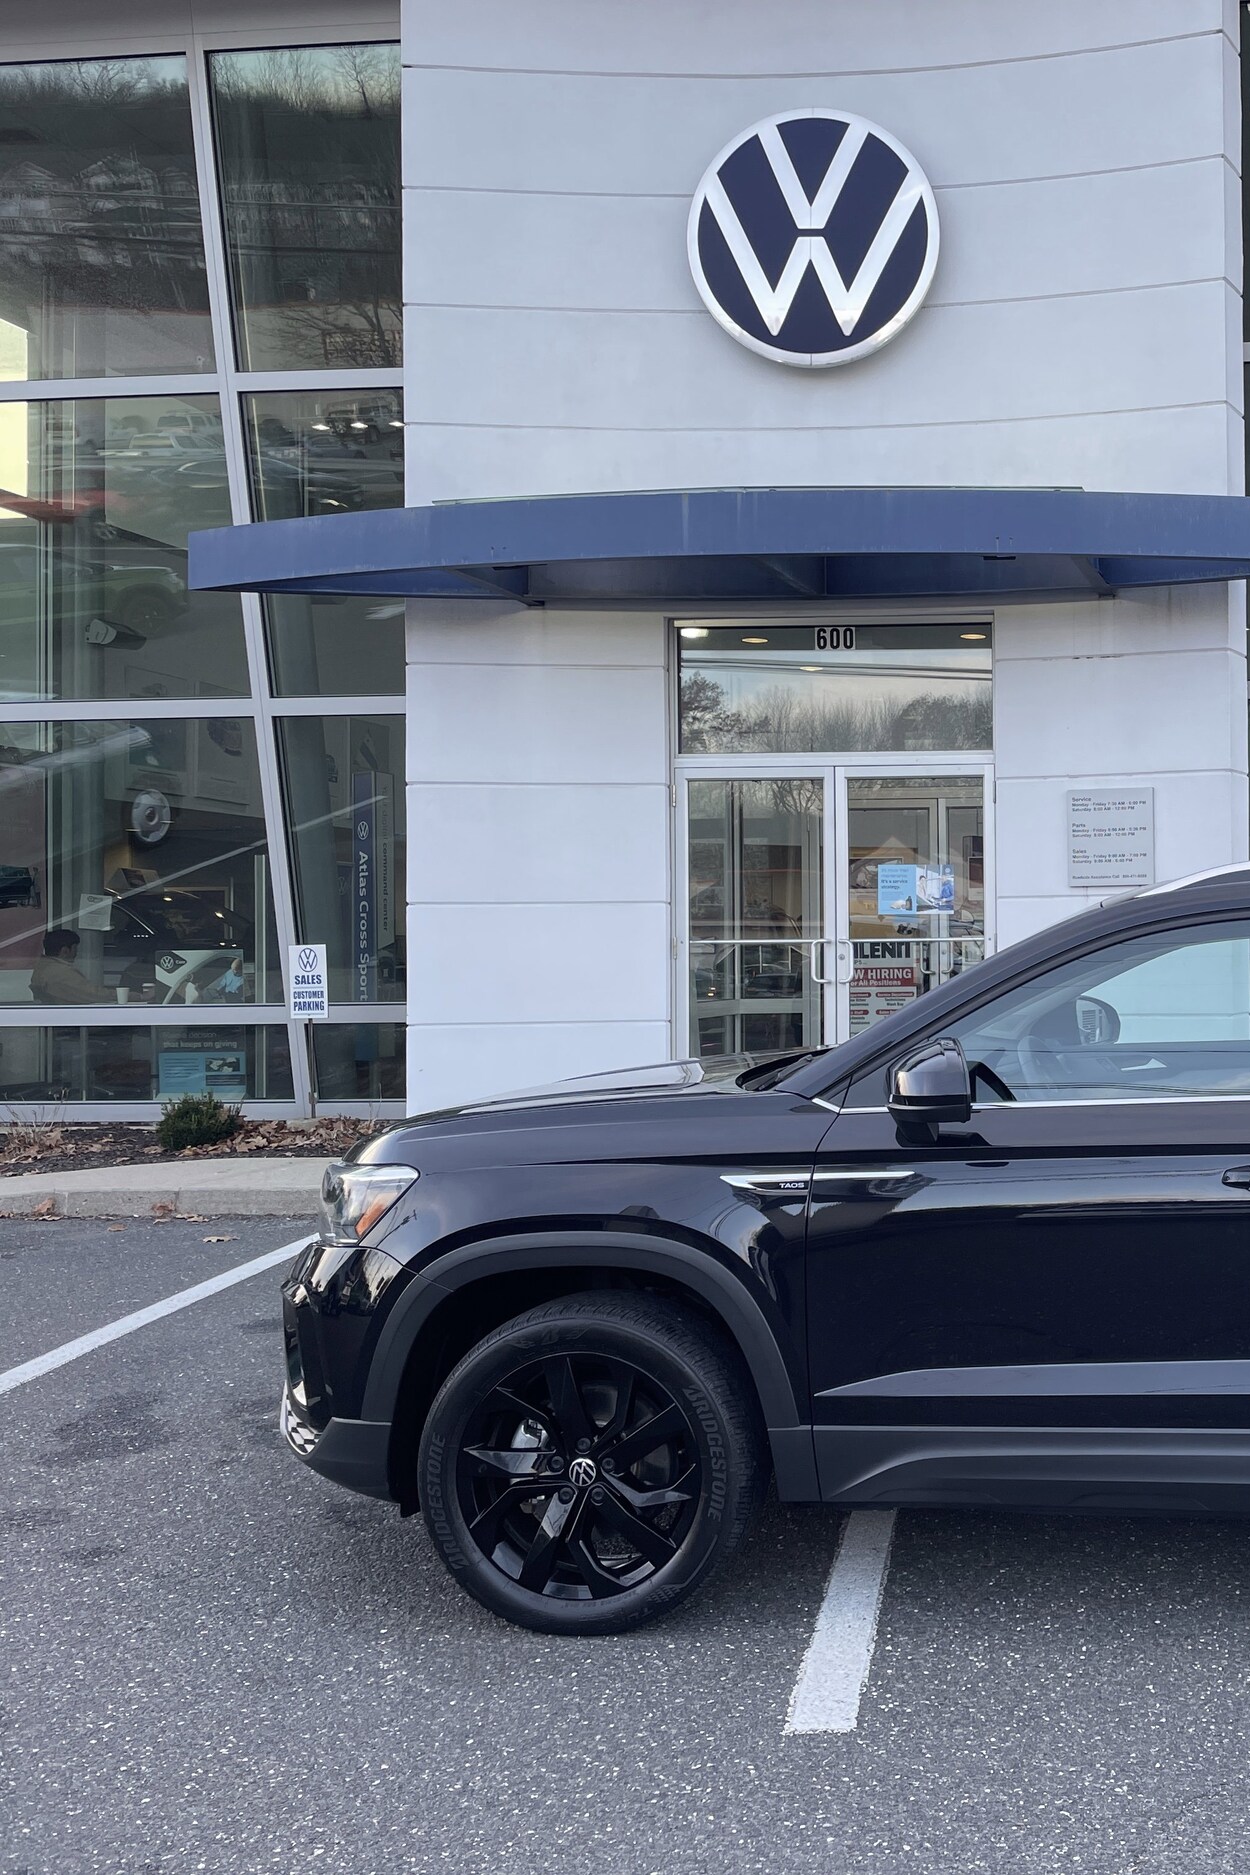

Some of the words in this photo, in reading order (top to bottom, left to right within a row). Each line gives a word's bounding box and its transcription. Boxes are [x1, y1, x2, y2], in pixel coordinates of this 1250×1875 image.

[816, 628, 854, 650] 600
[359, 852, 369, 896] Atlas
[360, 902, 369, 948] Cross
[294, 974, 322, 985] SALES
[358, 954, 370, 1002] Sport
[868, 968, 912, 979] HIRING
[293, 990, 324, 1000] CUSTOMER
[294, 1001, 324, 1011] PARKING
[215, 1040, 237, 1048] giving
[682, 1384, 727, 1522] BRIDGESTONE
